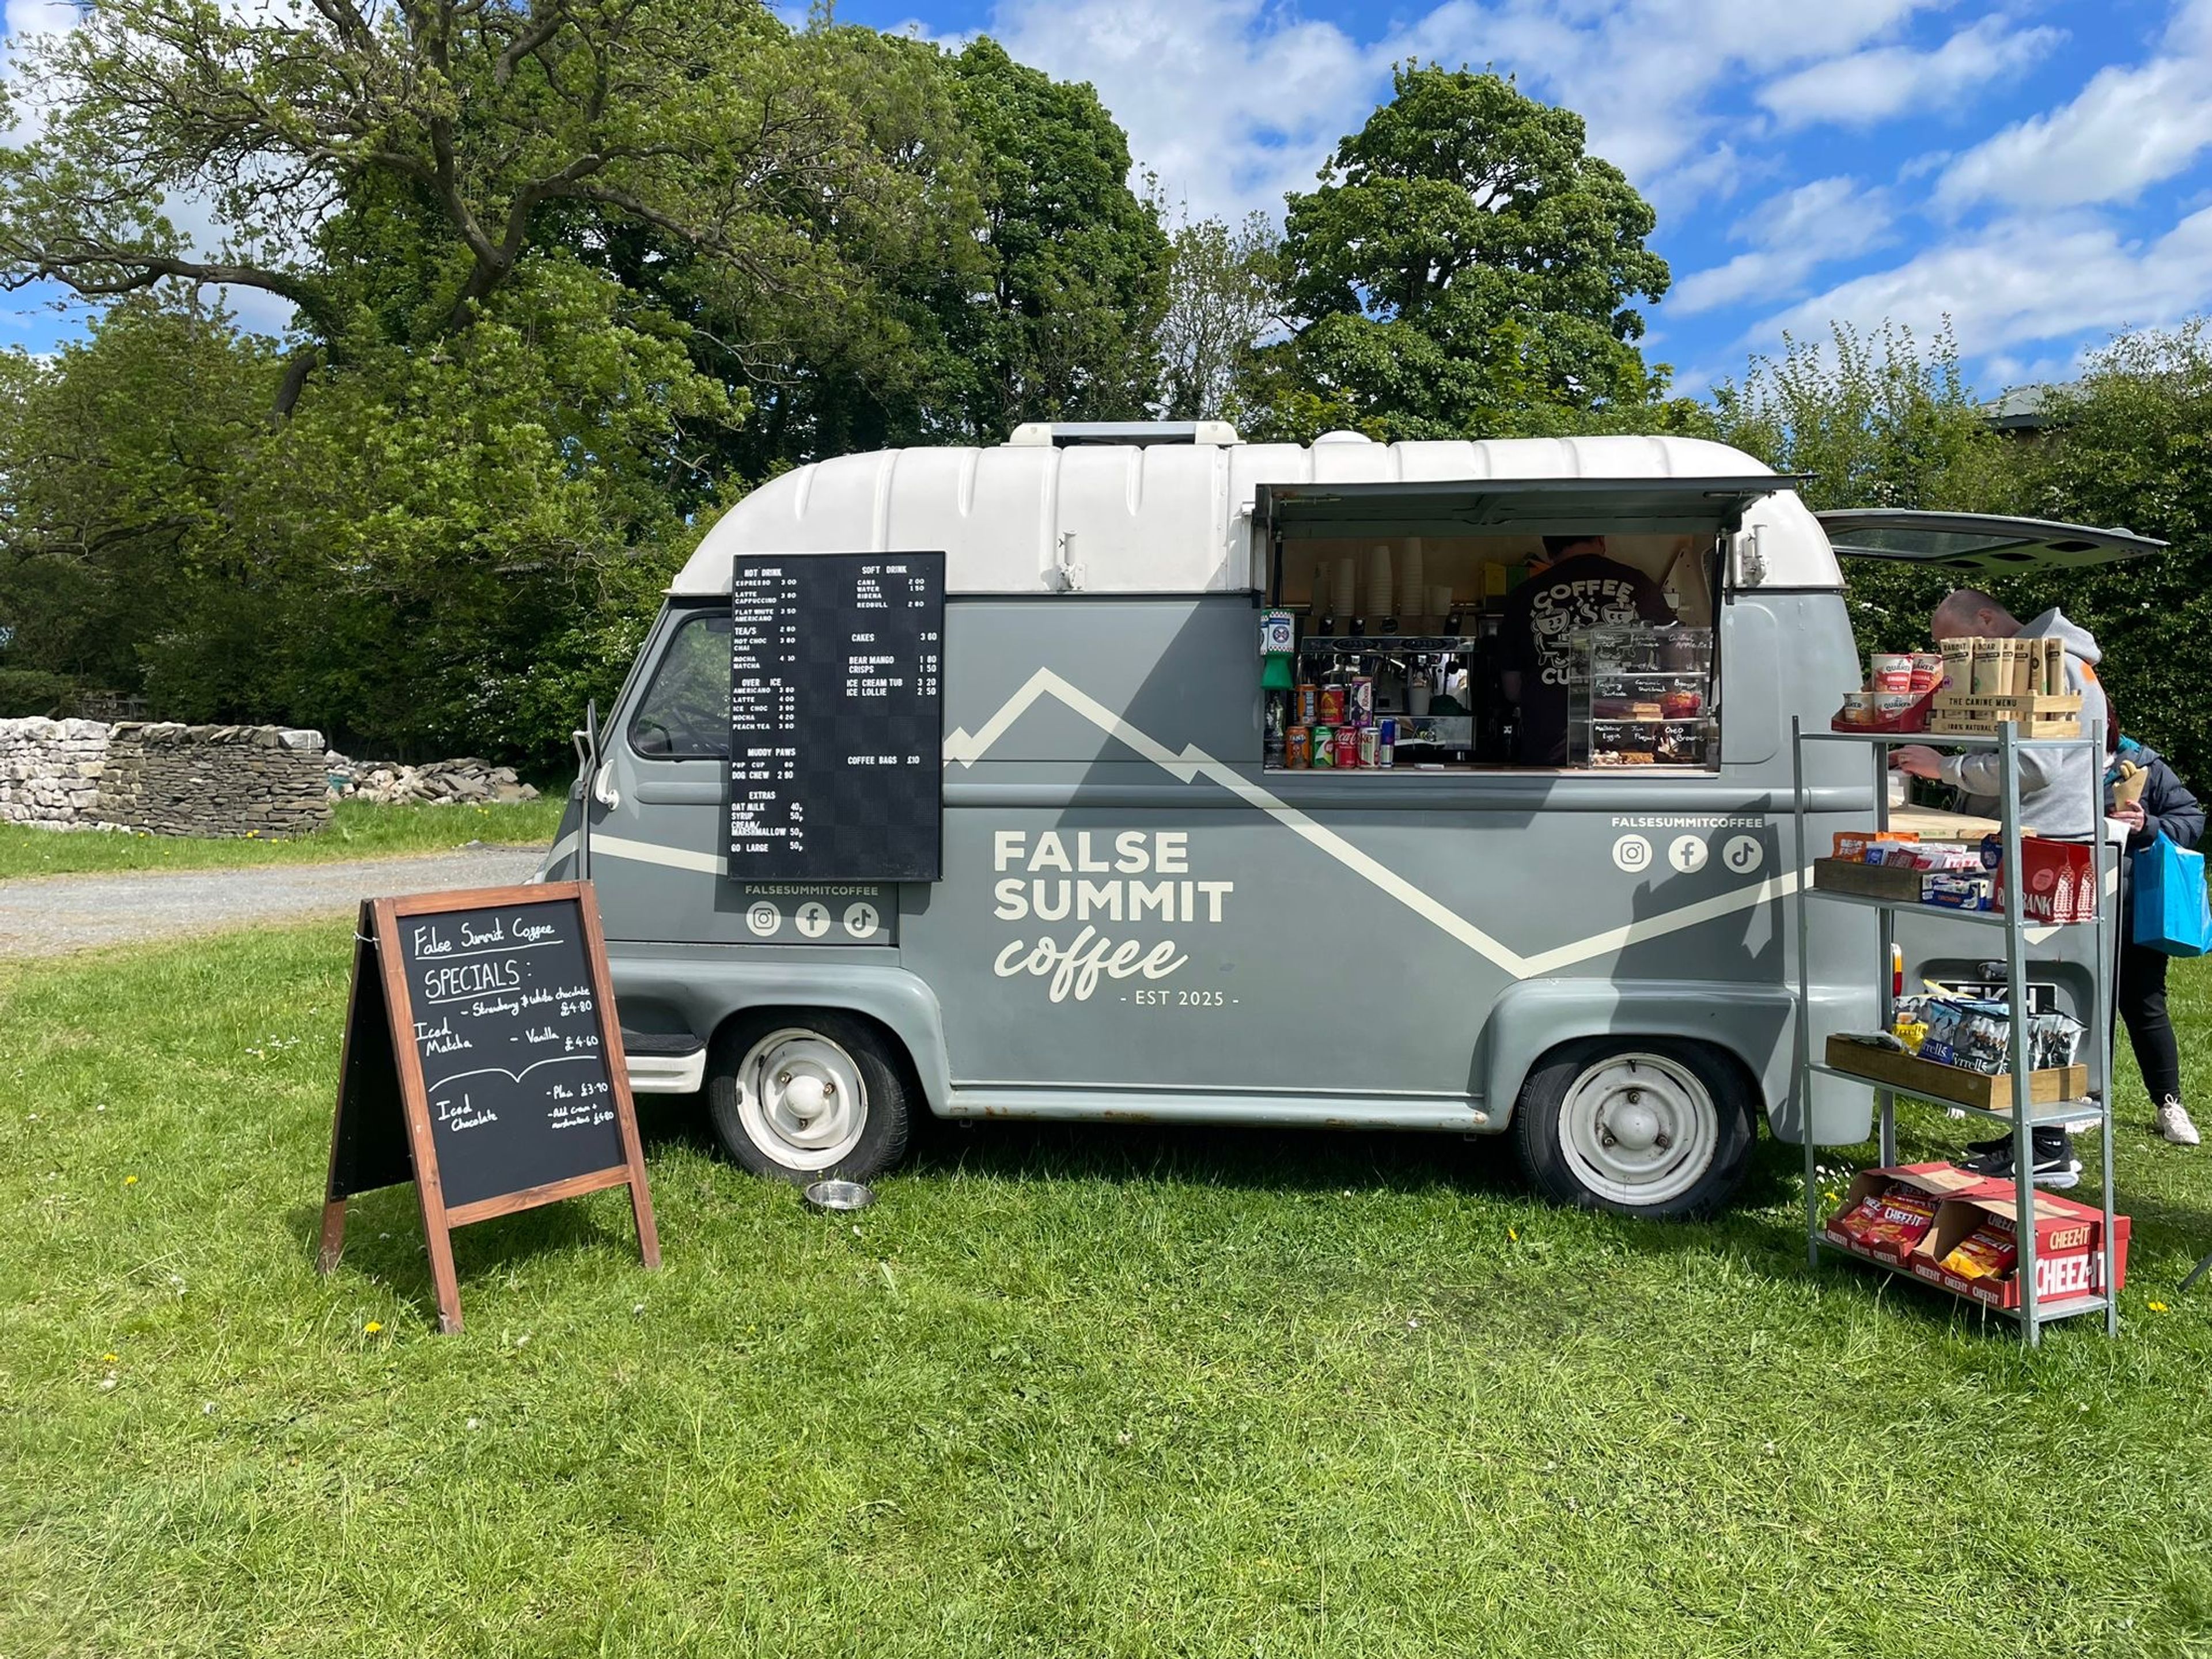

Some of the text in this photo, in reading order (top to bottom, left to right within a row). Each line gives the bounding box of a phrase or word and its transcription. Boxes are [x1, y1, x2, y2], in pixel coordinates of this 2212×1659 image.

[862, 566, 880, 574] SOFT
[1533, 579, 1634, 609] COFFEE
[734, 627, 756, 635] TEA/S
[852, 634, 874, 642] CAKES
[849, 656, 868, 664] BEAR
[869, 656, 894, 664] MANGO
[849, 665, 874, 673] CRISPS
[742, 678, 781, 687] OVER ICE
[847, 679, 858, 687] ICE
[862, 679, 887, 687] CREAM
[862, 688, 887, 696] LOLLIE
[1965, 698, 1992, 706] CANINE
[747, 748, 796, 756] MUDDY PAWS
[847, 756, 919, 764] COFFEE BAGS £10
[732, 771, 745, 779] DOG
[749, 791, 776, 800] EXTRAS
[732, 803, 745, 811] OAT
[747, 803, 765, 811] MILK
[1612, 817, 1762, 828] FALSESUMMITCOFFEE
[731, 843, 741, 852] GO
[746, 843, 768, 852] LARGE
[994, 831, 1188, 874] FALSE
[745, 885, 878, 895] FALSESUMMITCOFFEE
[993, 878, 1233, 922] SUMMIT
[414, 918, 555, 956] False Summit Coffee
[994, 924, 1188, 1003] coffee
[555, 986, 590, 1000] chocolate
[1136, 990, 1224, 1006] EST 2025
[414, 1017, 452, 1041] Iced
[526, 1027, 559, 1043] Vanilla
[426, 1034, 472, 1056] Matcha
[436, 1093, 472, 1120] Iced
[451, 1109, 498, 1132] Chocolate
[1884, 1207, 1923, 1226] CHEEZ-IT
[2050, 1226, 2090, 1250] CHEEZ-IT
